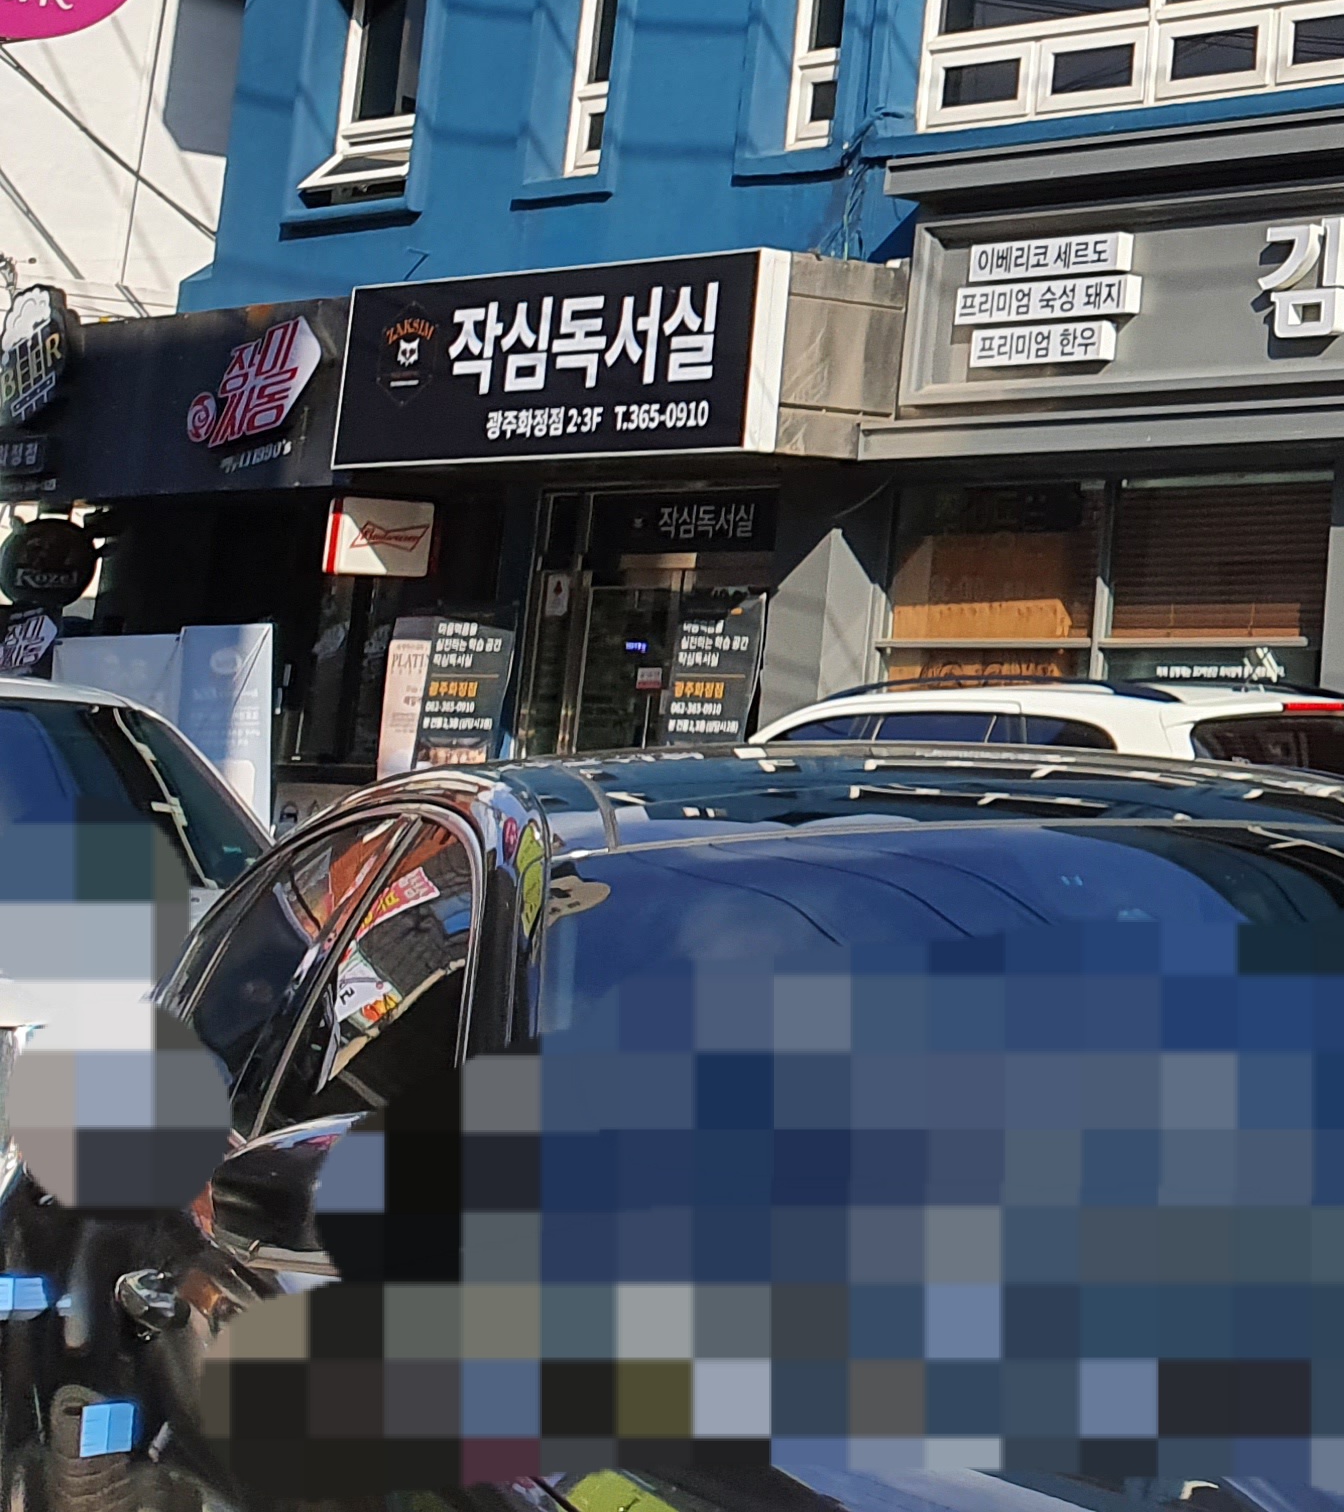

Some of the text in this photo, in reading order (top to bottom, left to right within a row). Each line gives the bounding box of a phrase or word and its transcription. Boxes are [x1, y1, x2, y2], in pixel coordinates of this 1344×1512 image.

[977, 240, 1109, 275] 이베리코 세르도
[958, 279, 1122, 318] 프리미엄 숙성 돼지
[385, 317, 437, 345] ZAKSIM
[448, 281, 720, 395] 작심독서실
[976, 326, 1096, 361] 프리미엄 한우
[486, 400, 709, 440] 광주화정점 2·3F T.365-0910
[658, 503, 756, 539] 작심독서실
[14, 567, 79, 589] Kozel
[391, 653, 427, 668] PLATI
